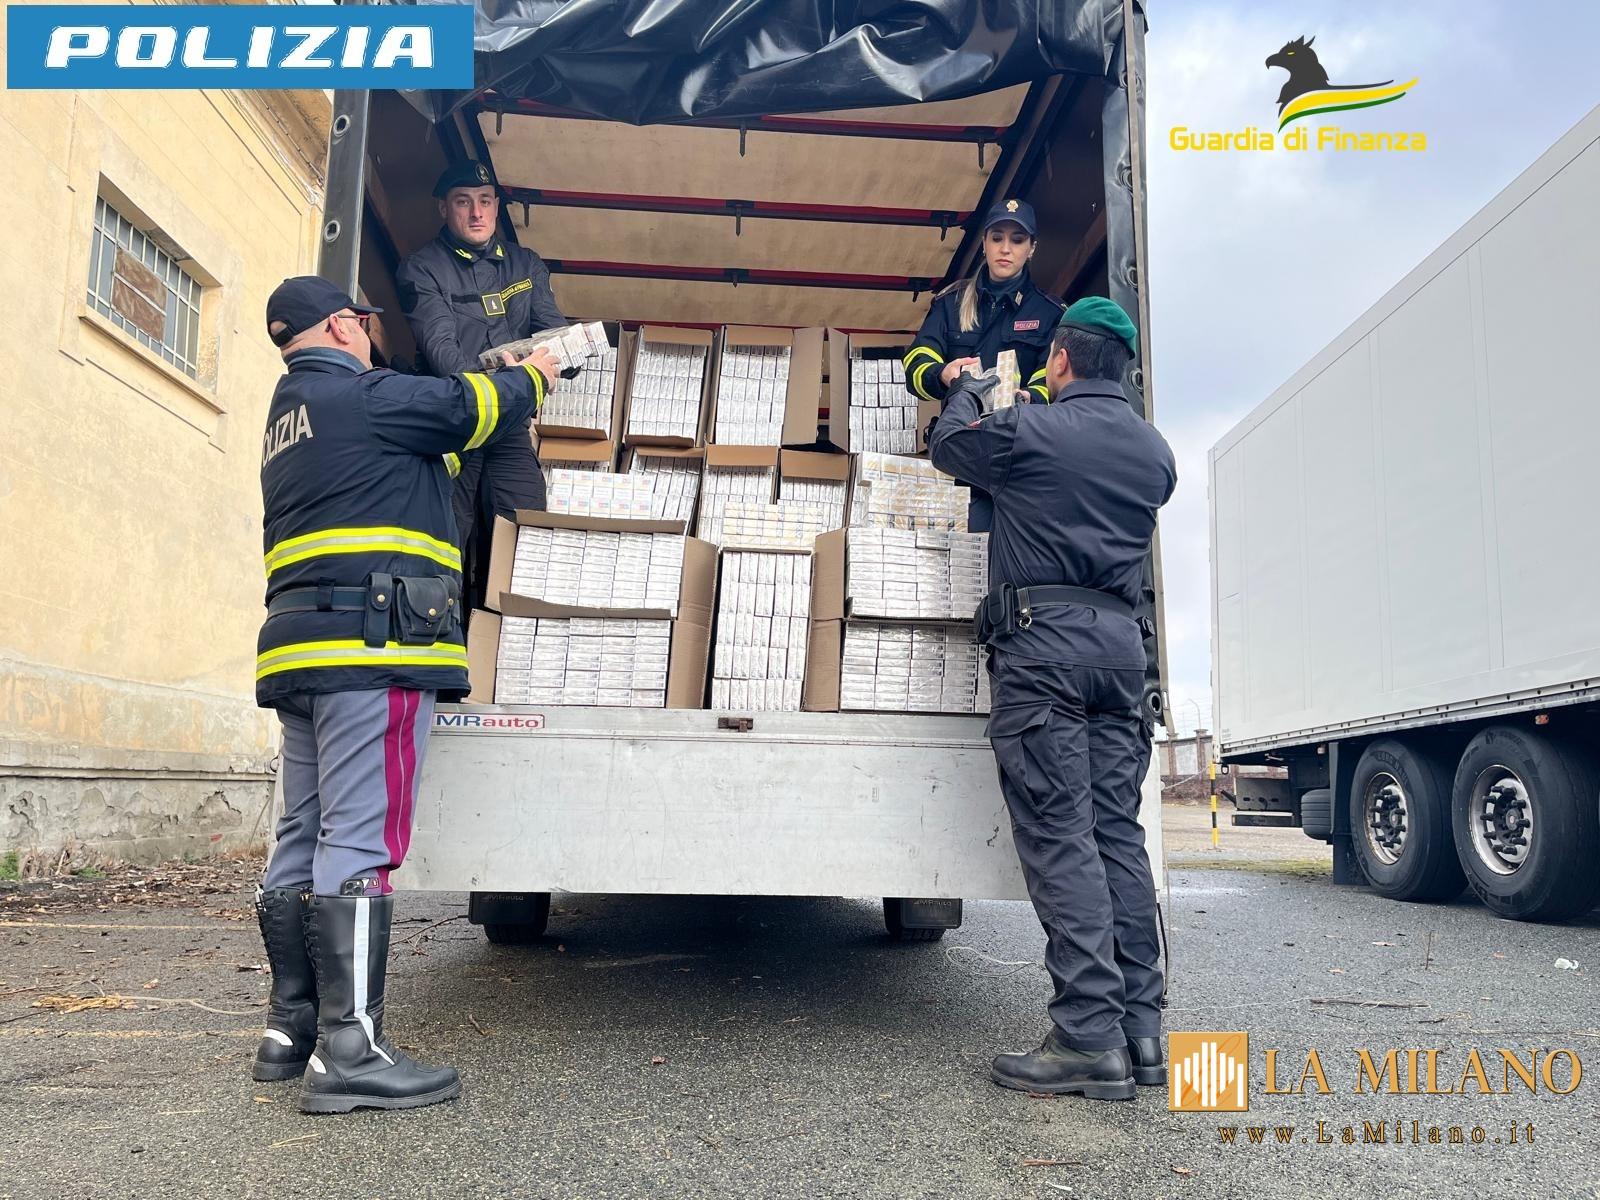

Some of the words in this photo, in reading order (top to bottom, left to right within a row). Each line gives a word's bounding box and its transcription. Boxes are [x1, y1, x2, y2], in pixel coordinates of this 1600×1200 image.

[1015, 321, 1038, 329] POLIZIA
[262, 404, 314, 467] OLIZIA
[436, 714, 539, 728] MRauto
